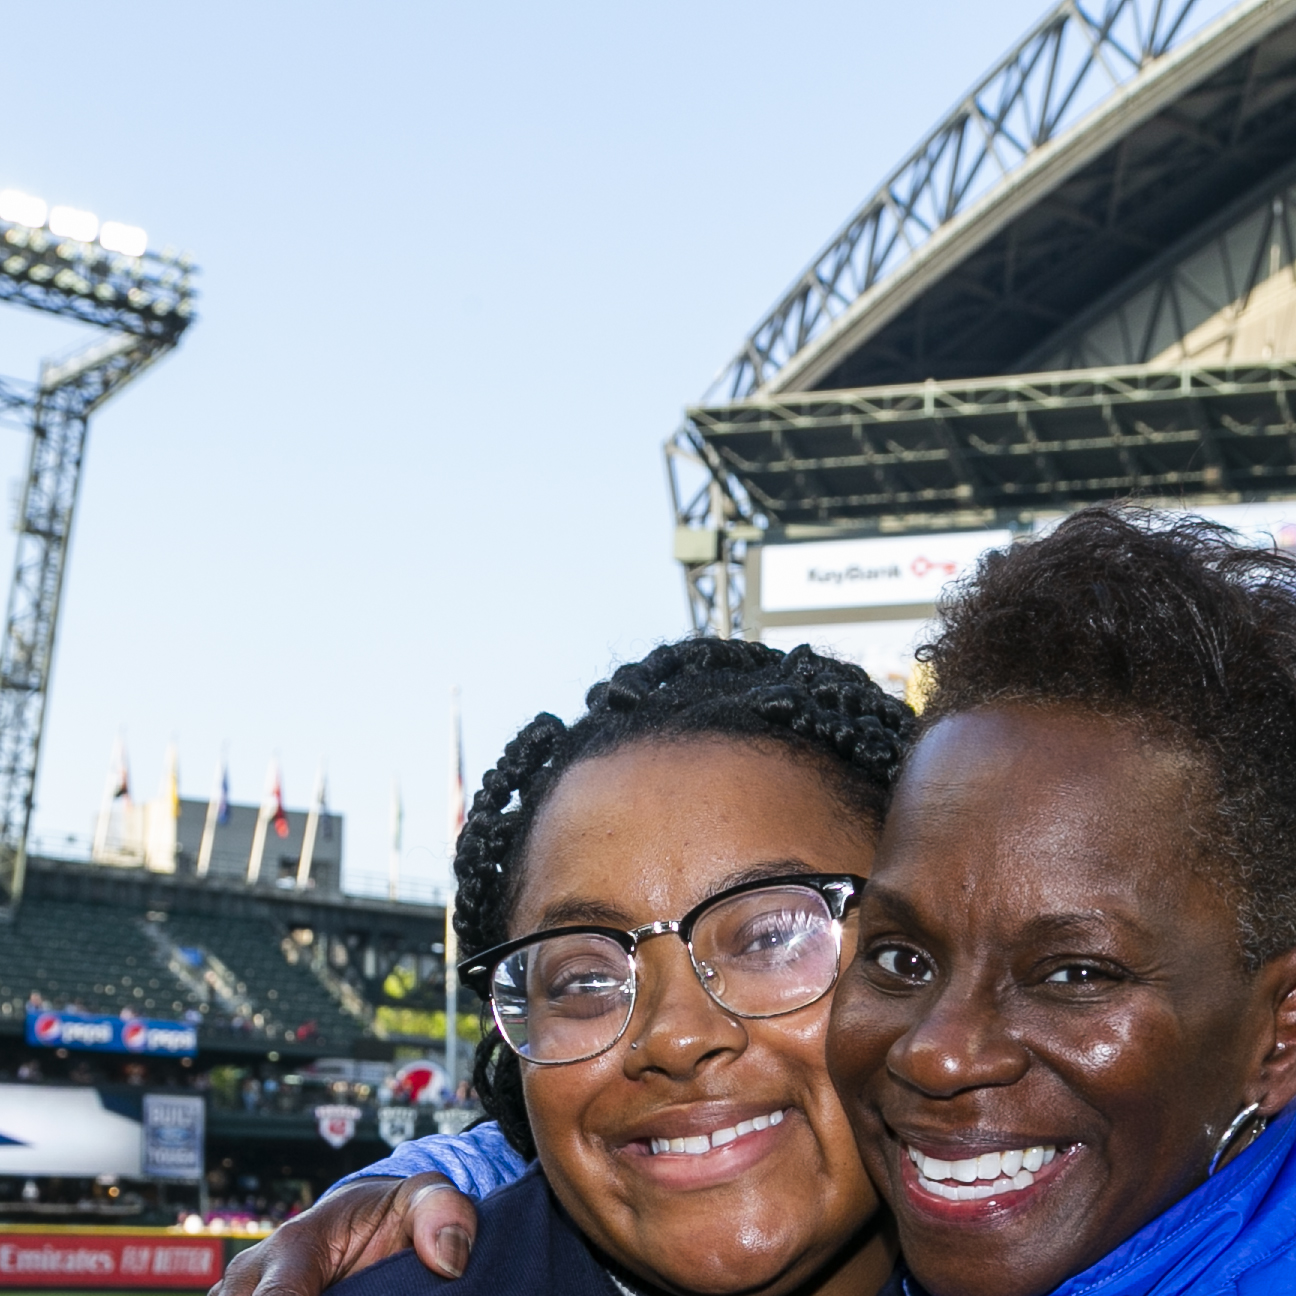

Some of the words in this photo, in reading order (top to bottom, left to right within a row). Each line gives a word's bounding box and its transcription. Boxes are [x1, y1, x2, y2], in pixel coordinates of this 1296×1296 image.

[807, 564, 902, 584] KeyBank
[61, 1021, 114, 1045] pepsi
[145, 1028, 197, 1053] pepsi
[119, 1245, 150, 1275] FLY
[151, 1246, 214, 1275] BETTER
